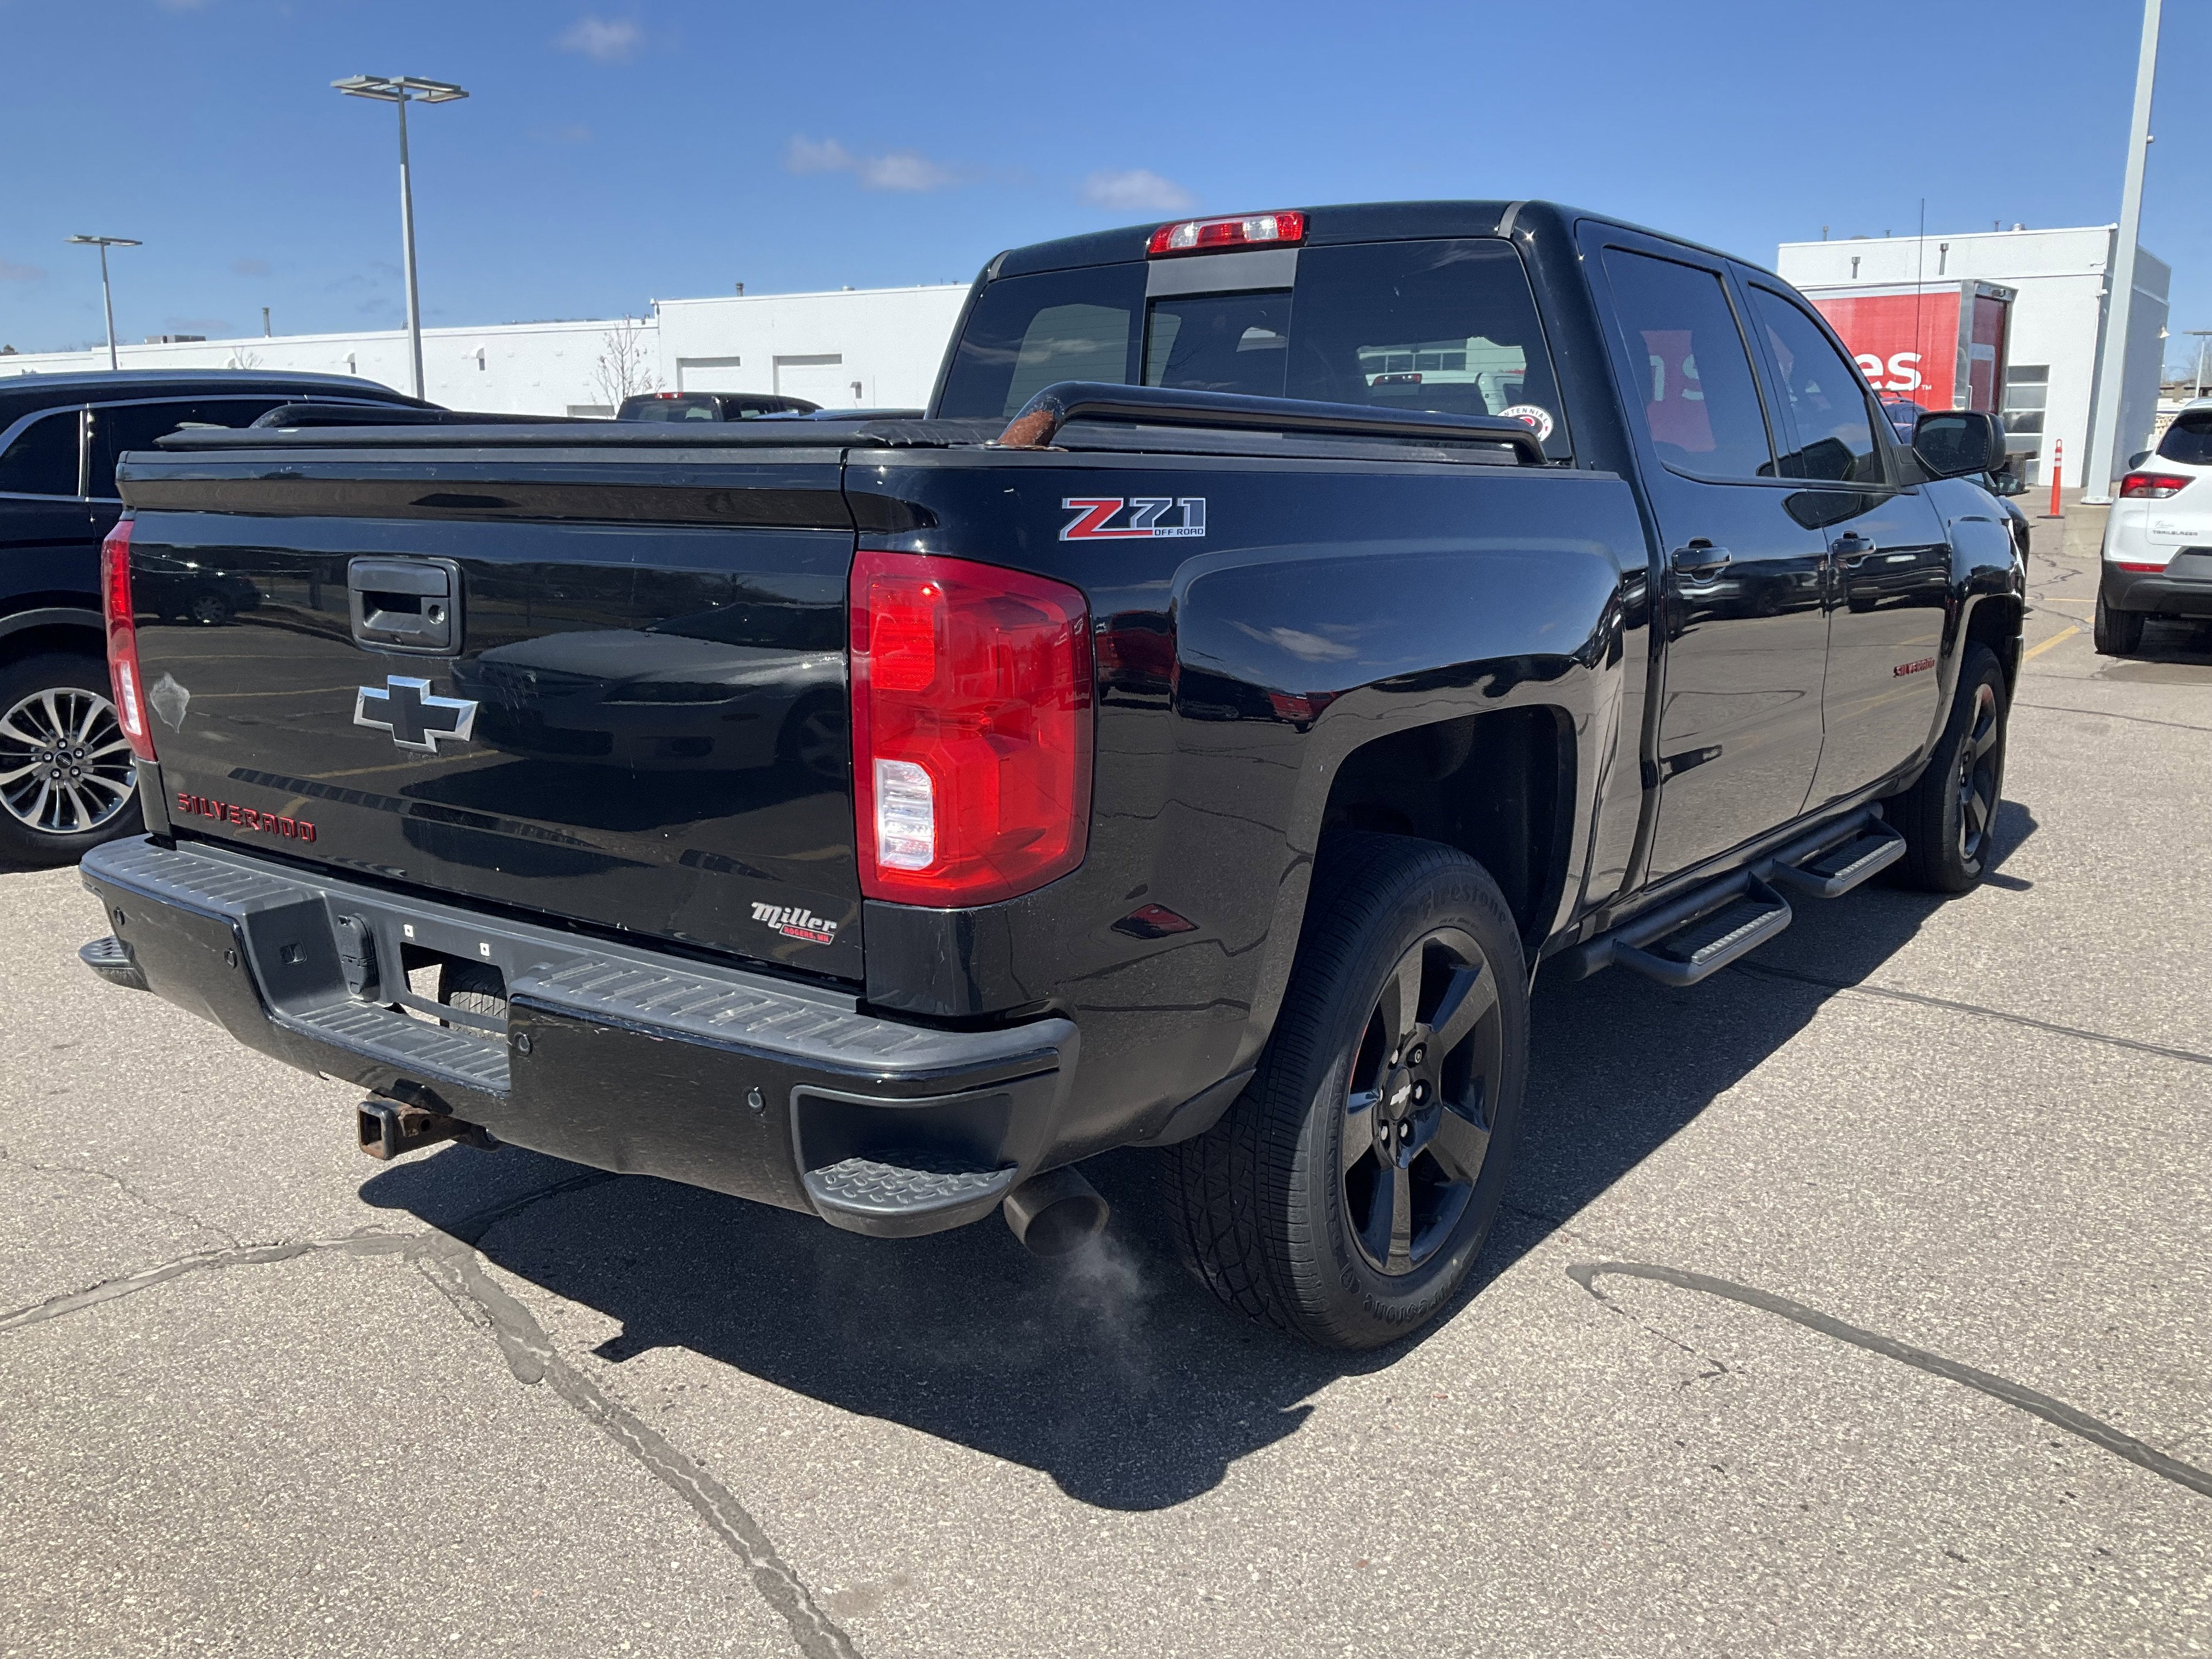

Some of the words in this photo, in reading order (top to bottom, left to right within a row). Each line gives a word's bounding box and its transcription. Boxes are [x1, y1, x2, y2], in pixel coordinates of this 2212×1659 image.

[1854, 352, 1922, 391] es
[1504, 408, 1548, 424] NTENNIAL
[1059, 498, 1206, 541] Z71
[177, 793, 317, 843] SILVERADO
[752, 902, 838, 932] Miller
[816, 934, 830, 943] MN
